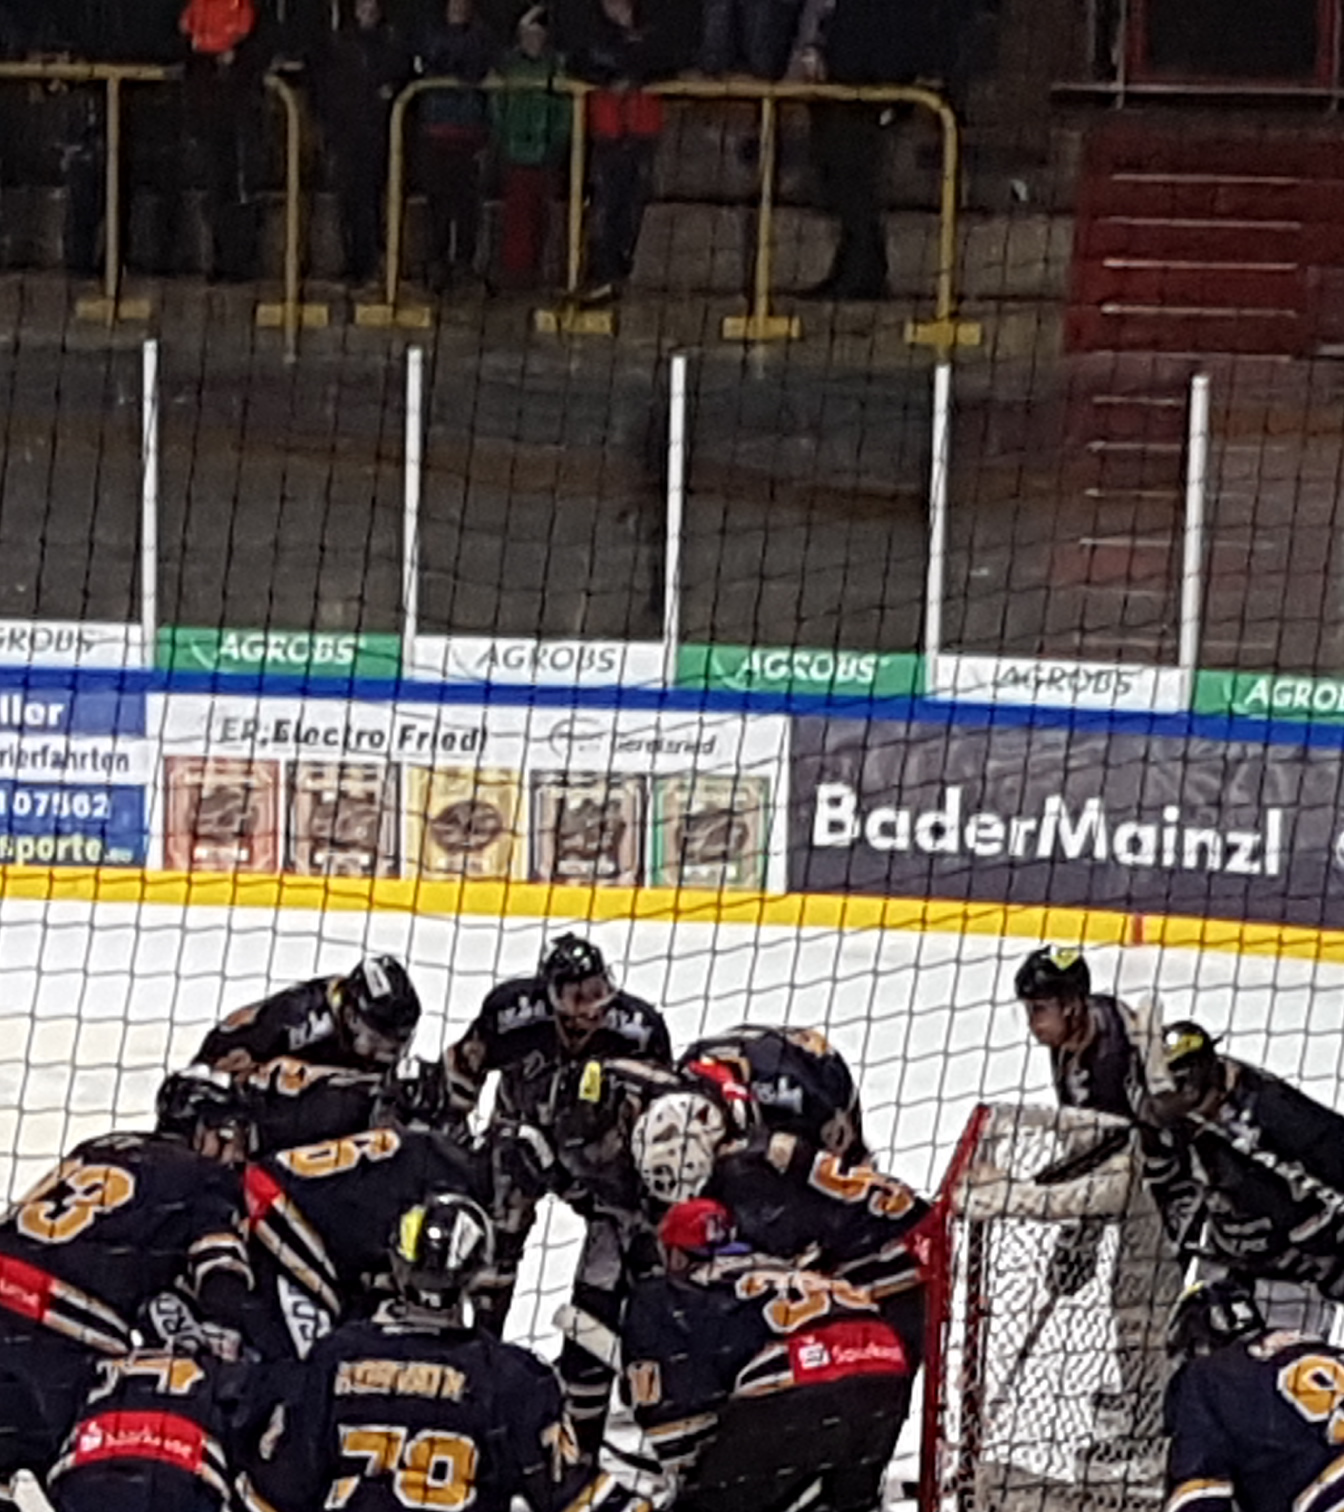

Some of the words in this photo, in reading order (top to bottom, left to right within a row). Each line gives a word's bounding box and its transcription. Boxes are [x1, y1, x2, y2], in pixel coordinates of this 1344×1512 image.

[218, 633, 356, 665] AGROBS
[475, 646, 617, 673] AGROBS
[733, 651, 878, 684] AGROBS
[812, 782, 1282, 876] BaderMainzl
